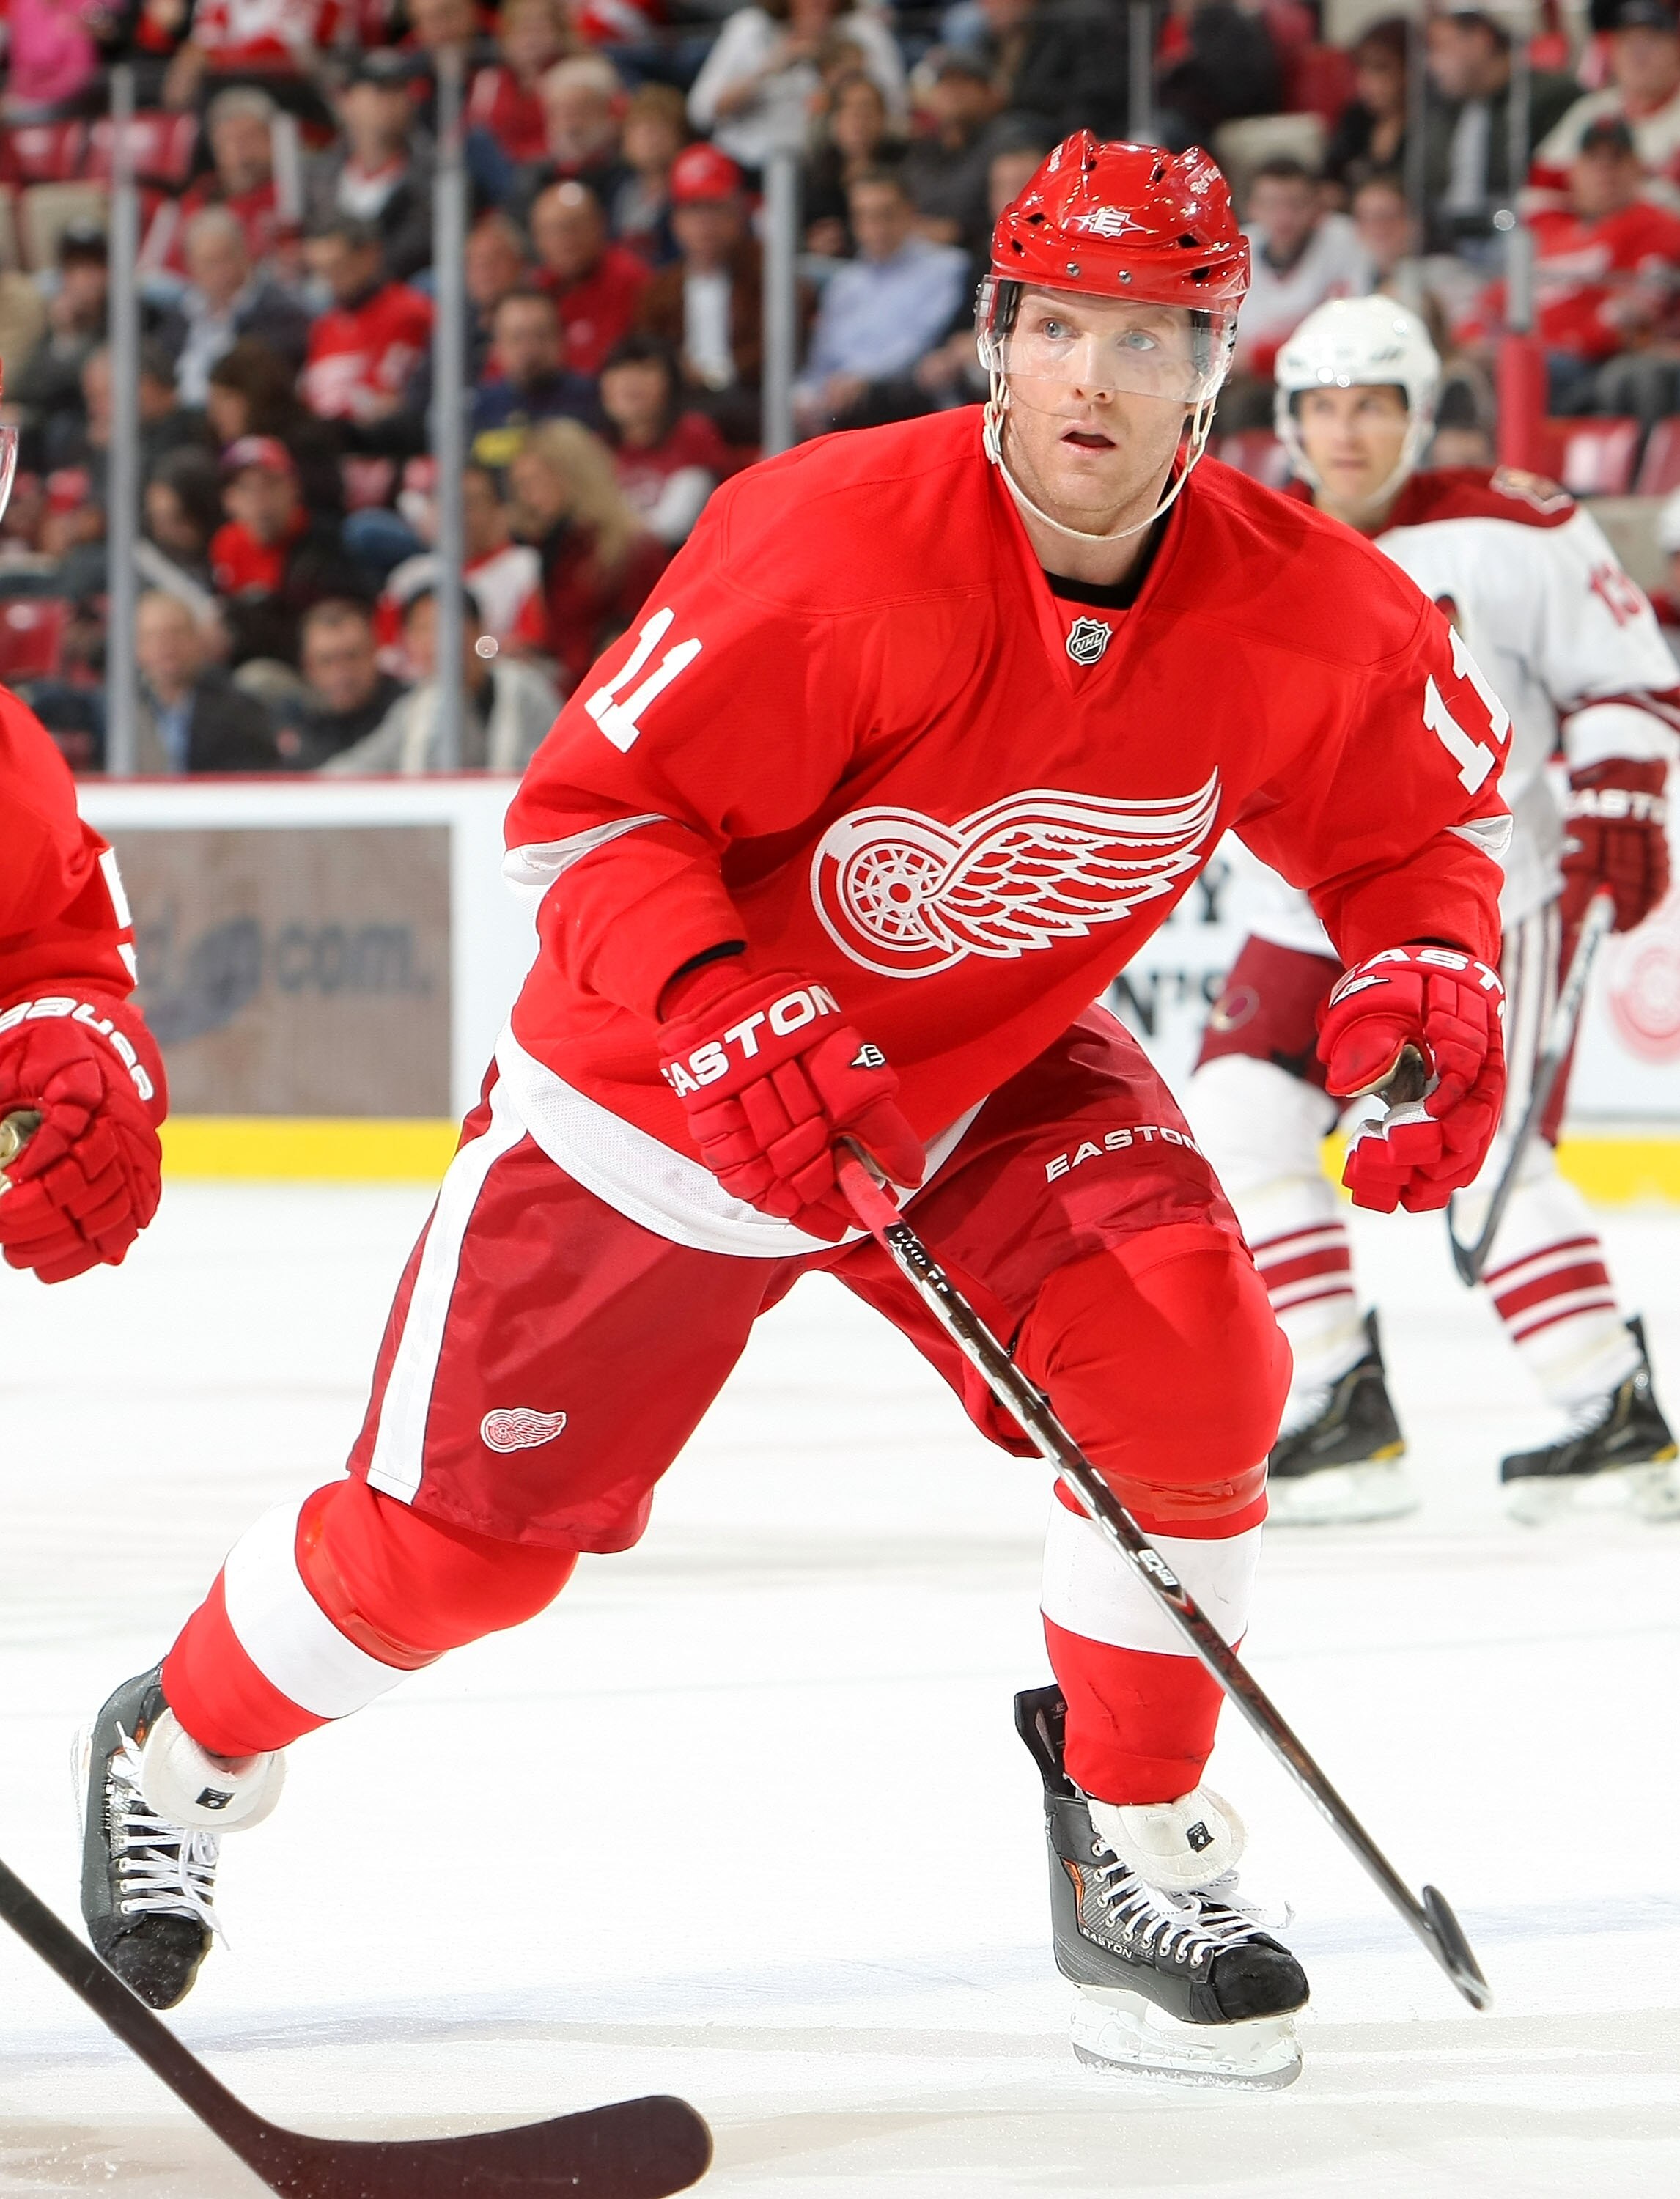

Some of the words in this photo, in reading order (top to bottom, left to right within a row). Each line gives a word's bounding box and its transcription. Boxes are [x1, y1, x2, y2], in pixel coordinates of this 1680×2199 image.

[1588, 563, 1643, 628] 13
[1074, 633, 1102, 653] NHL
[583, 605, 703, 754] 11
[1422, 624, 1511, 796] 11
[1083, 1926, 1133, 1959] EASTON
